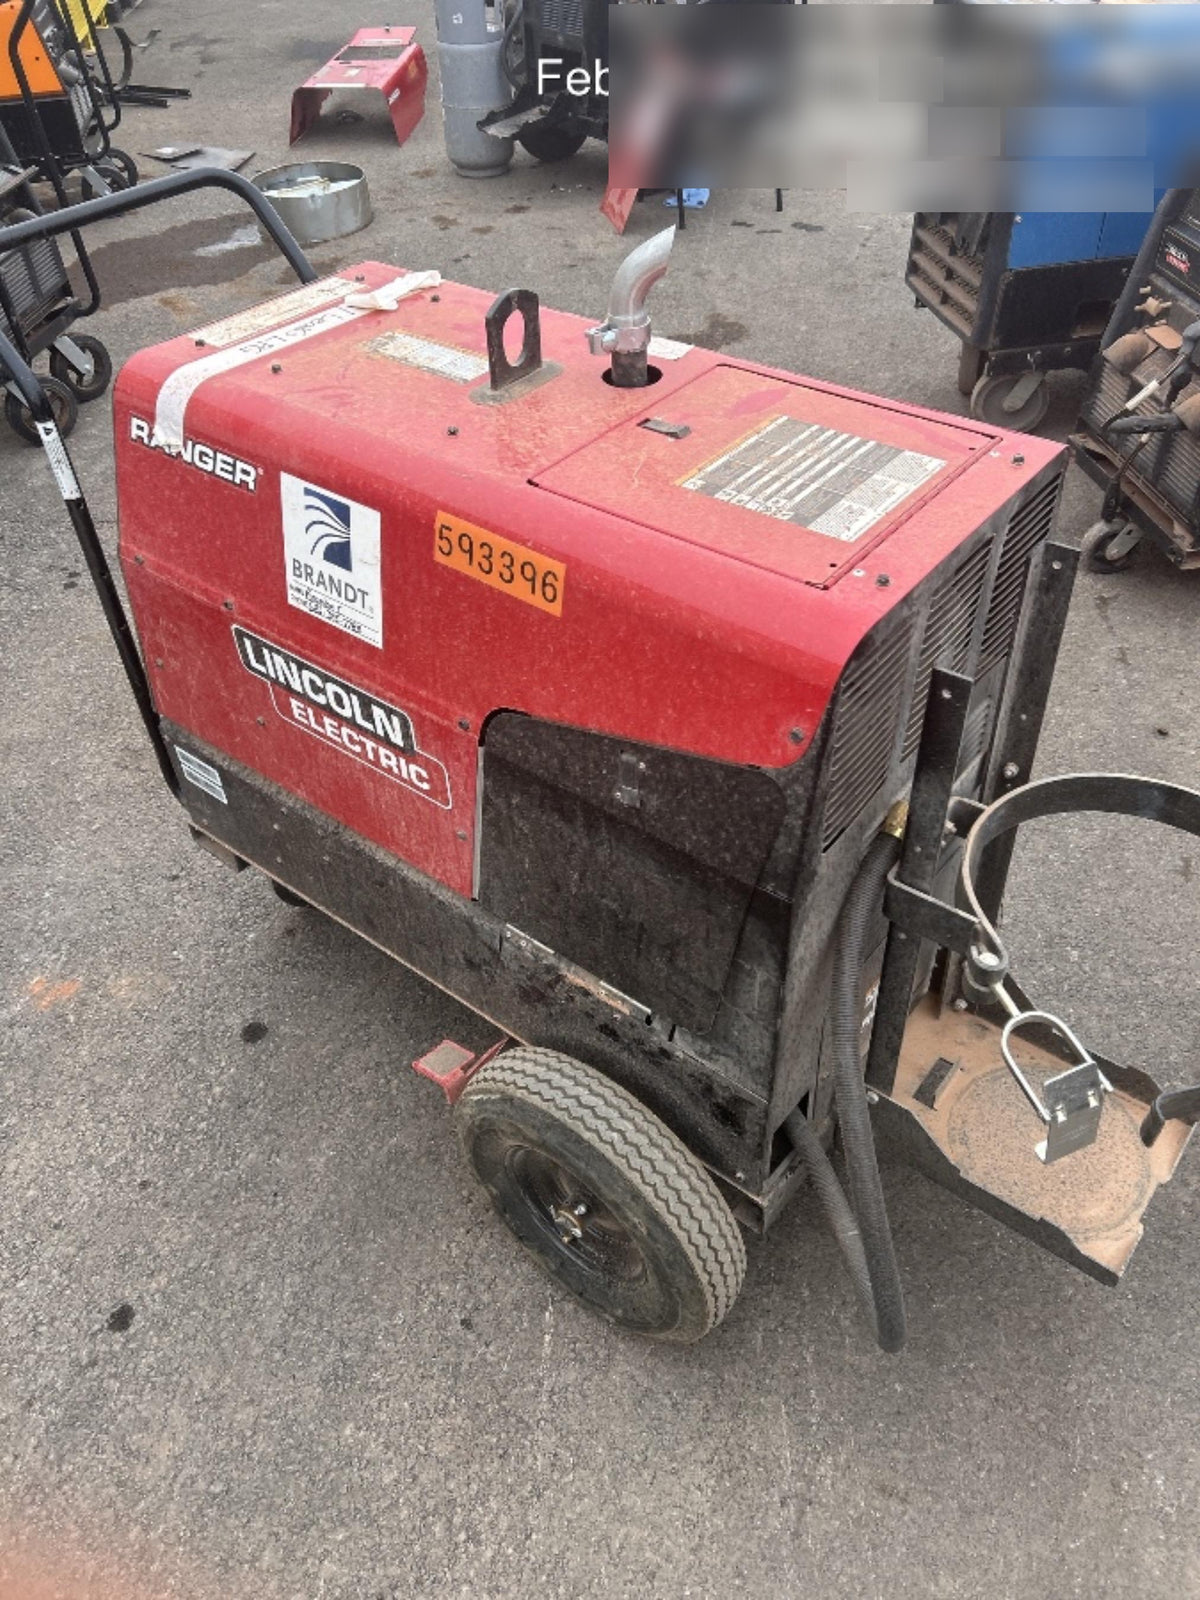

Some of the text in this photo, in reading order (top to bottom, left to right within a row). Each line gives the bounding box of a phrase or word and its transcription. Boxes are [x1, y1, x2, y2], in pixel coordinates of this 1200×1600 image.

[292, 557, 369, 609] BRANDT
[438, 523, 559, 603] 593396
[243, 637, 405, 747] LINCOLN
[289, 697, 431, 790] ELECTRIC
